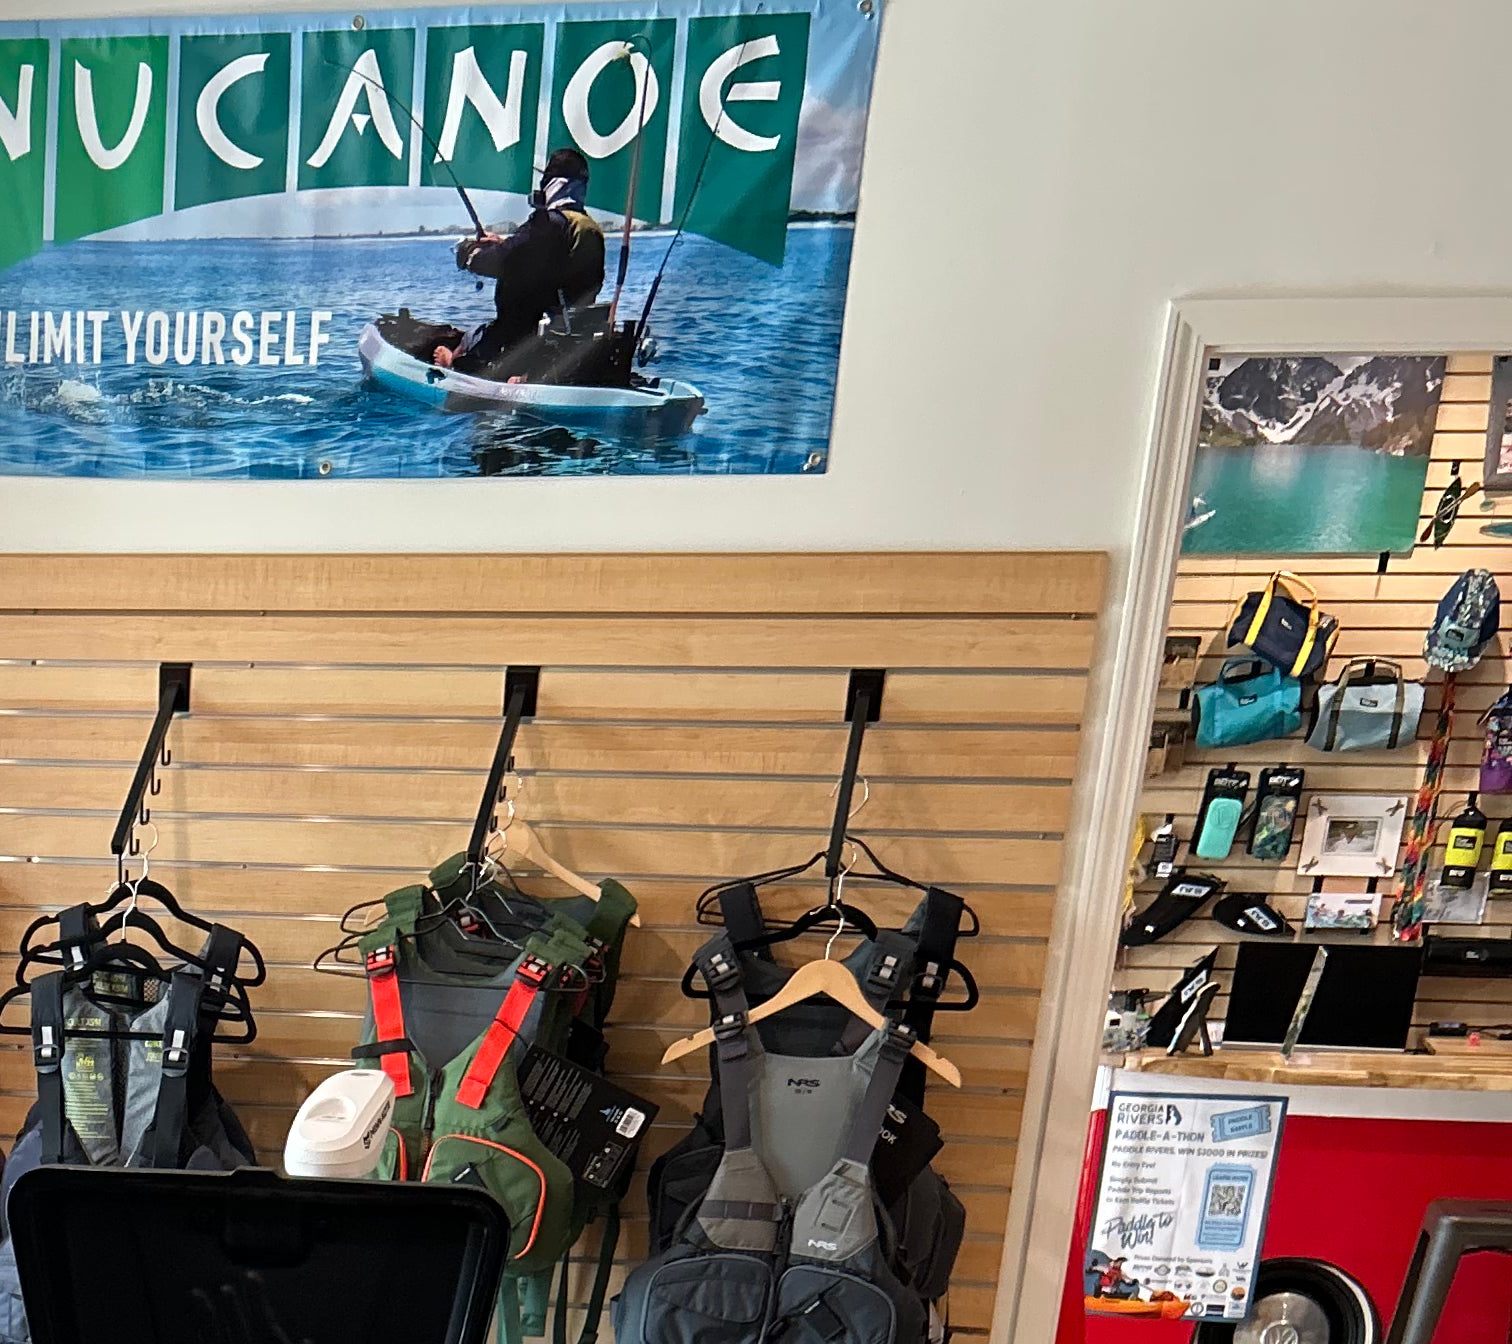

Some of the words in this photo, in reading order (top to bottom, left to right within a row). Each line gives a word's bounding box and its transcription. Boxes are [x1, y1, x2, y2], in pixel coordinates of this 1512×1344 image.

[120, 309, 334, 367] YOURSELF
[787, 1077, 821, 1088] NRS
[1118, 1102, 1165, 1114] GEORGIA
[1116, 1112, 1164, 1125] RIVERS
[807, 1238, 838, 1251] NRS
